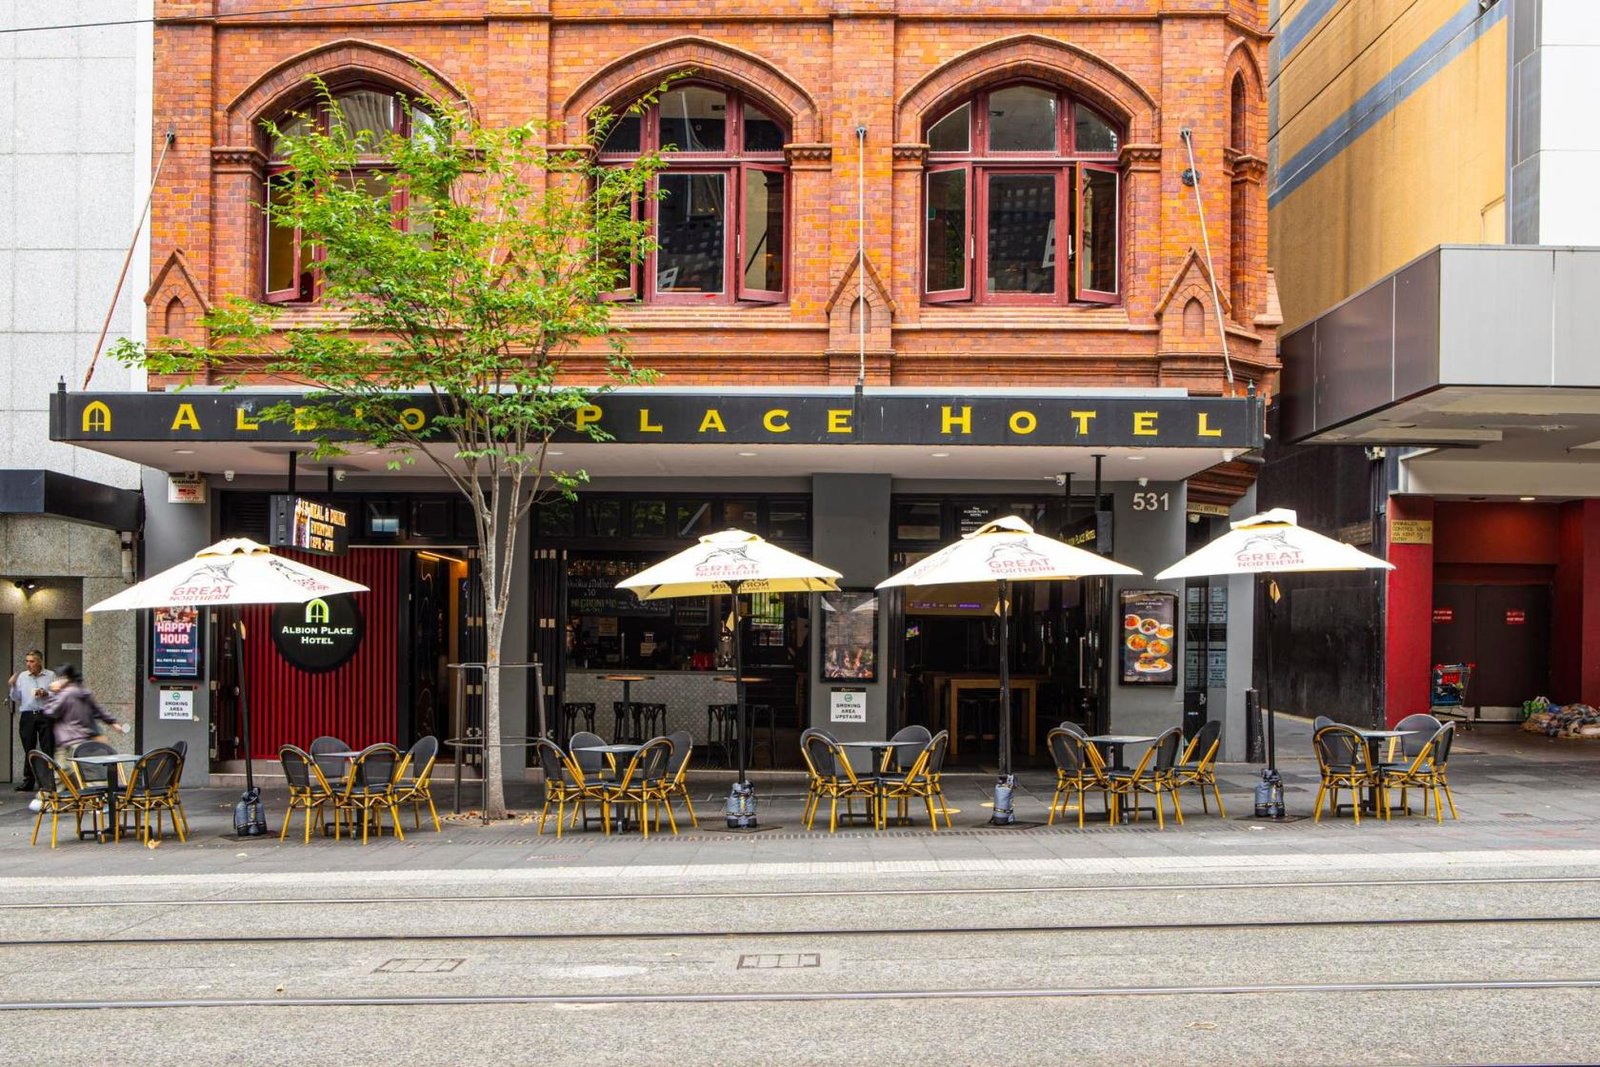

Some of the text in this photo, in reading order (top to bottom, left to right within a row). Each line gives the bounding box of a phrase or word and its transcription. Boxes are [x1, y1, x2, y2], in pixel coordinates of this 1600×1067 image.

[575, 404, 854, 434] PLACE
[940, 405, 1222, 438] HOTEL
[1133, 492, 1169, 511] 531
[1237, 551, 1302, 561] GREAT
[695, 564, 757, 572] GREAT
[988, 558, 1050, 568] GREAT
[1238, 559, 1304, 567] NORTHERN
[173, 585, 234, 596] GREAT
[157, 622, 193, 632] HAPPY
[282, 626, 353, 635] ALBION PLACE
[160, 634, 189, 644] HOUR
[301, 636, 334, 644] HOTEL
